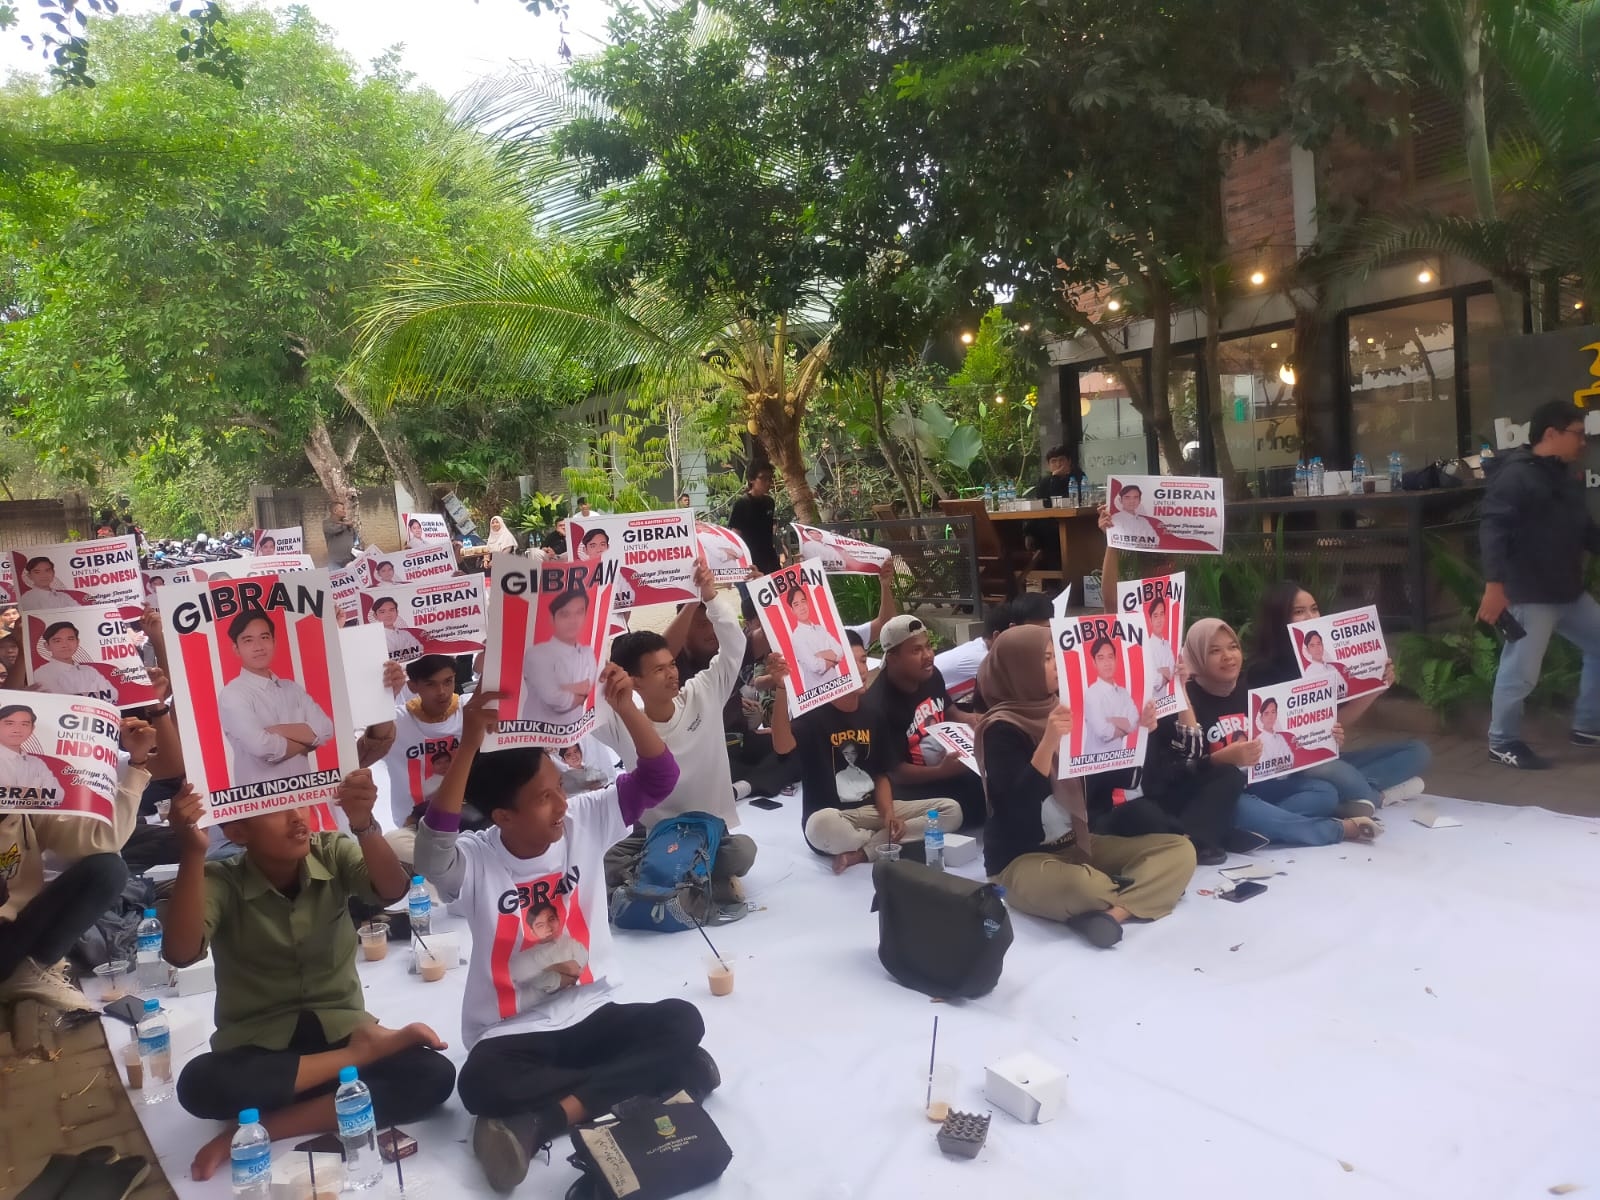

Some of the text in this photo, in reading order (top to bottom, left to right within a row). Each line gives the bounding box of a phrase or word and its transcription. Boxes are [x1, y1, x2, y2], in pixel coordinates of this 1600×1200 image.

[1154, 489, 1215, 500] GIBRAN
[1153, 506, 1218, 517] INDONESIA
[276, 537, 301, 546] GIBRAN
[622, 525, 689, 543] GIBRAN
[1112, 534, 1156, 543] GIBRAN
[623, 542, 649, 551] UNTUK
[624, 545, 693, 565] INDONESIA
[69, 550, 134, 569] GIBRAN
[402, 551, 449, 568] GIBRAN
[72, 568, 100, 576] UNTUK
[73, 568, 138, 588] INDONESIA
[330, 575, 355, 588] RAN
[405, 563, 454, 580] INDONESIA
[500, 559, 619, 595] GIBRAN
[411, 587, 478, 608] GIBRAN
[757, 568, 824, 608] GIBRAN
[1123, 580, 1183, 612] GIBRAN
[172, 582, 324, 635] GIBRAN
[413, 605, 481, 626] INDONESIA
[1059, 620, 1143, 651] GIBRAN
[1330, 620, 1376, 641] GIBRAN
[100, 637, 127, 645] UNTUK
[1335, 638, 1382, 660] INDONESIA
[1286, 687, 1332, 709] GIBRAN
[498, 708, 596, 735] UNTUK INDONSIA
[1287, 706, 1334, 729] INDONESIA
[57, 730, 96, 742] UNTUK
[497, 735, 537, 745] BANTEN
[538, 735, 569, 744] MUDA
[1096, 748, 1136, 762] INDONESIA
[1254, 754, 1291, 771] GIBRAN
[211, 769, 341, 805] UNTUK INDONESIA
[213, 801, 259, 819] BANTEN
[261, 794, 296, 809] MUDA
[497, 865, 580, 914] GBRAN
